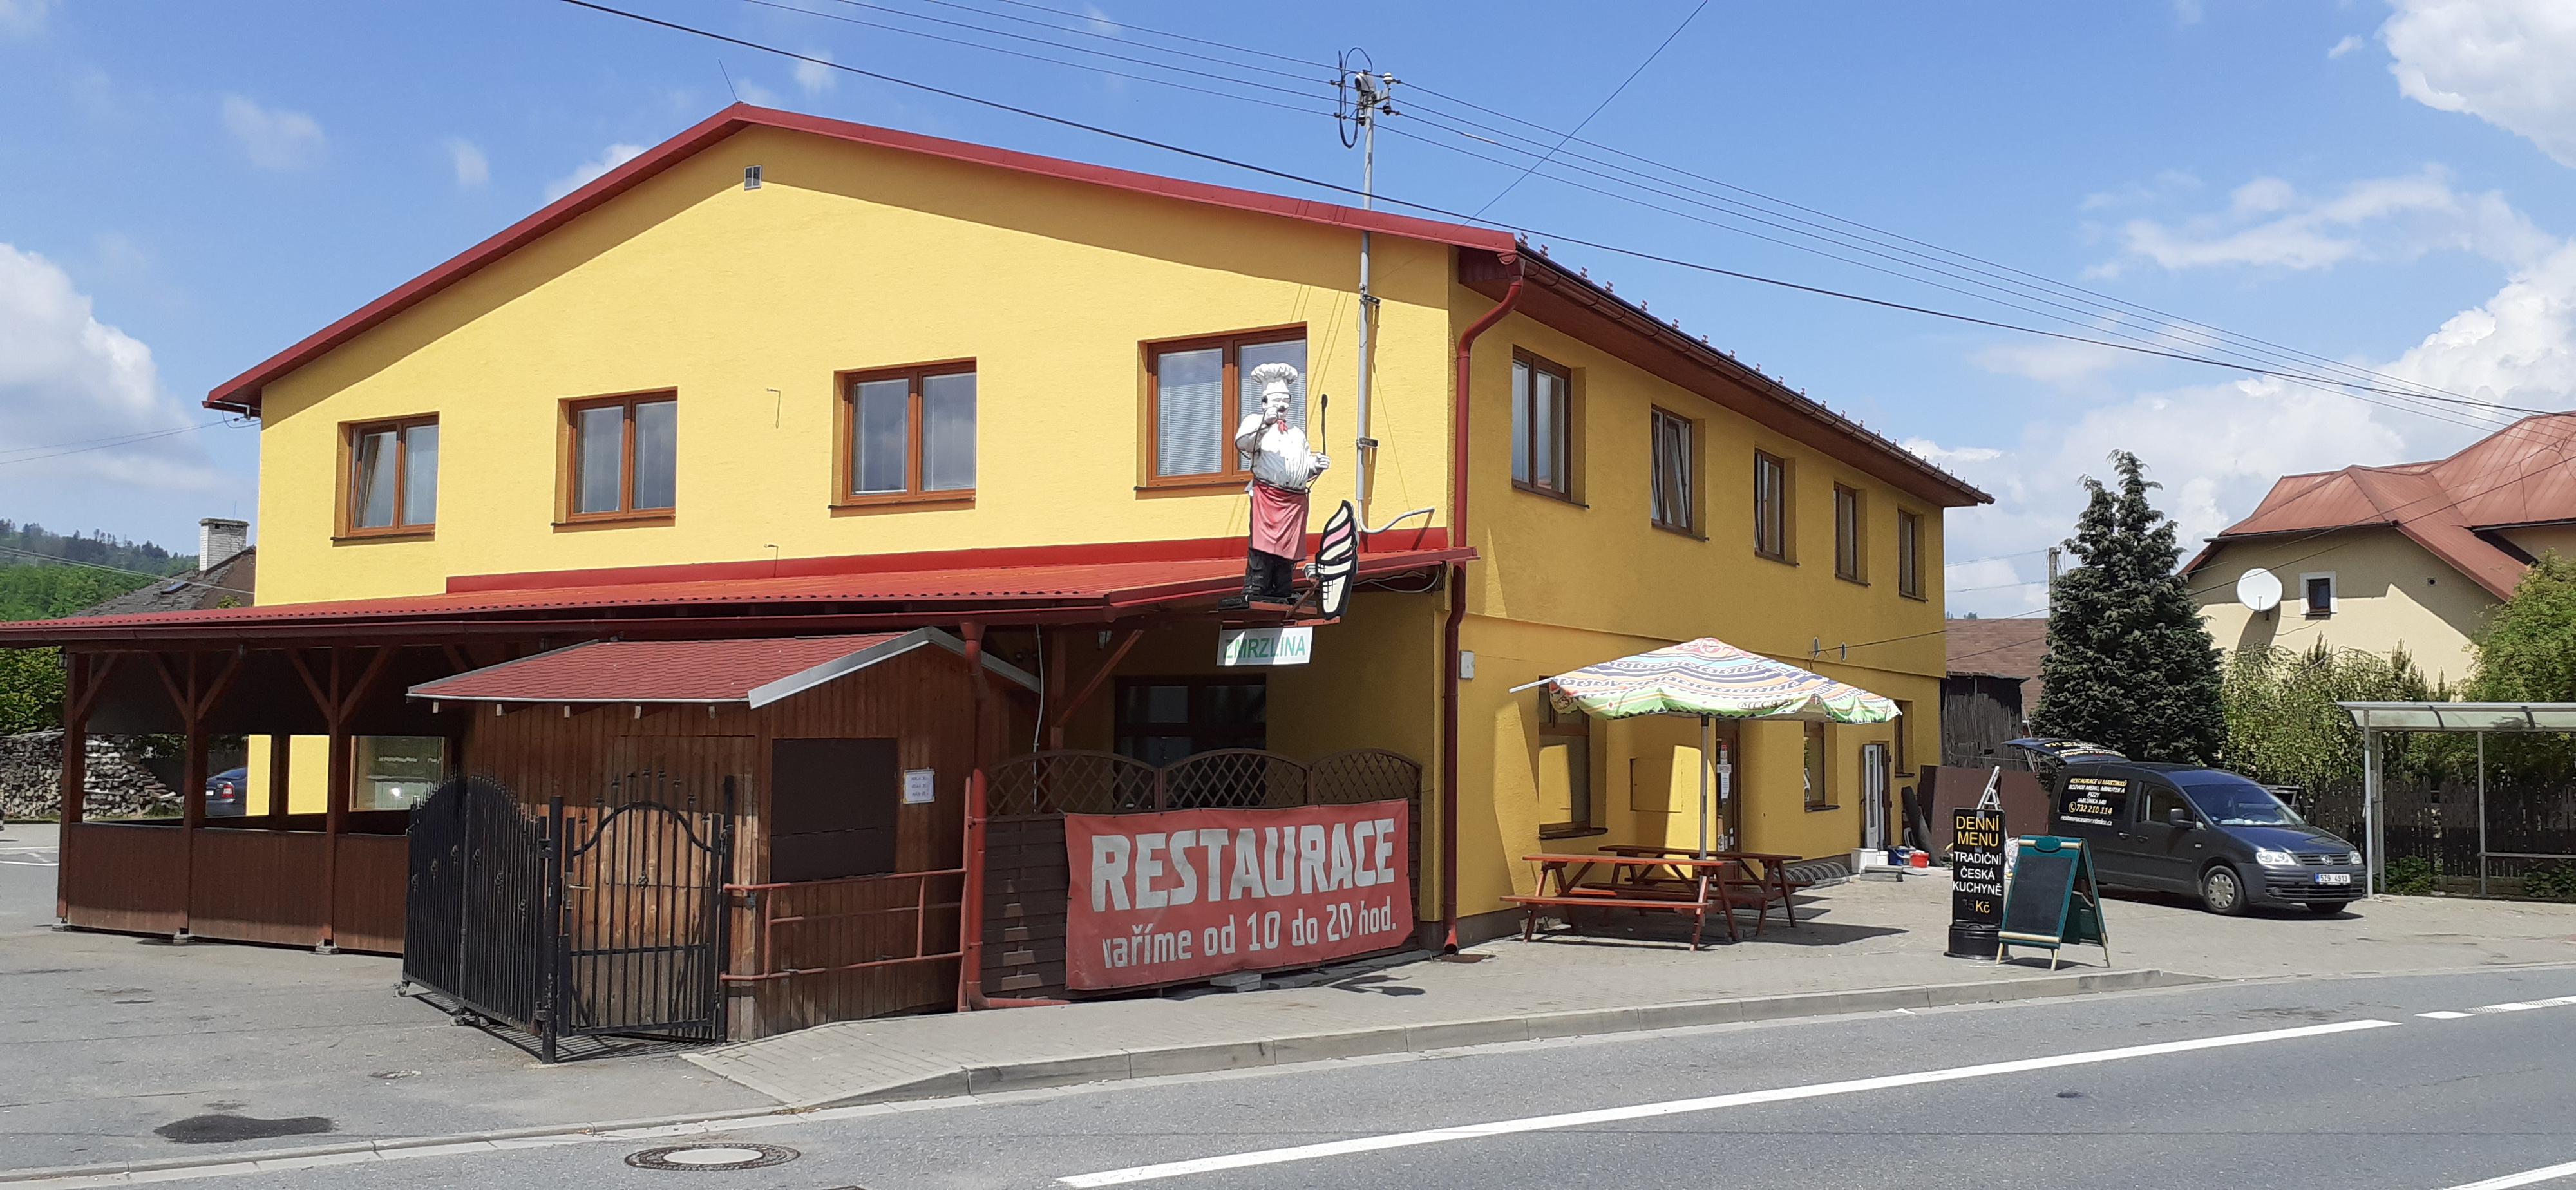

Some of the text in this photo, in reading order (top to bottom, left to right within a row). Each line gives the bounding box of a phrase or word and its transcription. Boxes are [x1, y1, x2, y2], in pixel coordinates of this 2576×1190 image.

[1224, 636, 1306, 659] ZMRZLINA
[2076, 804, 2088, 812] 732
[2087, 805, 2100, 814] 210
[1956, 814, 2000, 831] DENNÍ
[1958, 831, 1999, 847] MENU
[1092, 818, 1395, 912] RESTAURACE
[1954, 851, 2002, 865] TRADIČNÍ
[1960, 865, 1995, 880] ČESKÁ
[1953, 880, 2003, 896] KUCHYNĚ
[1975, 900, 1991, 913] Kč
[1102, 896, 1397, 969] vaříme od 10 do 20 hod.
